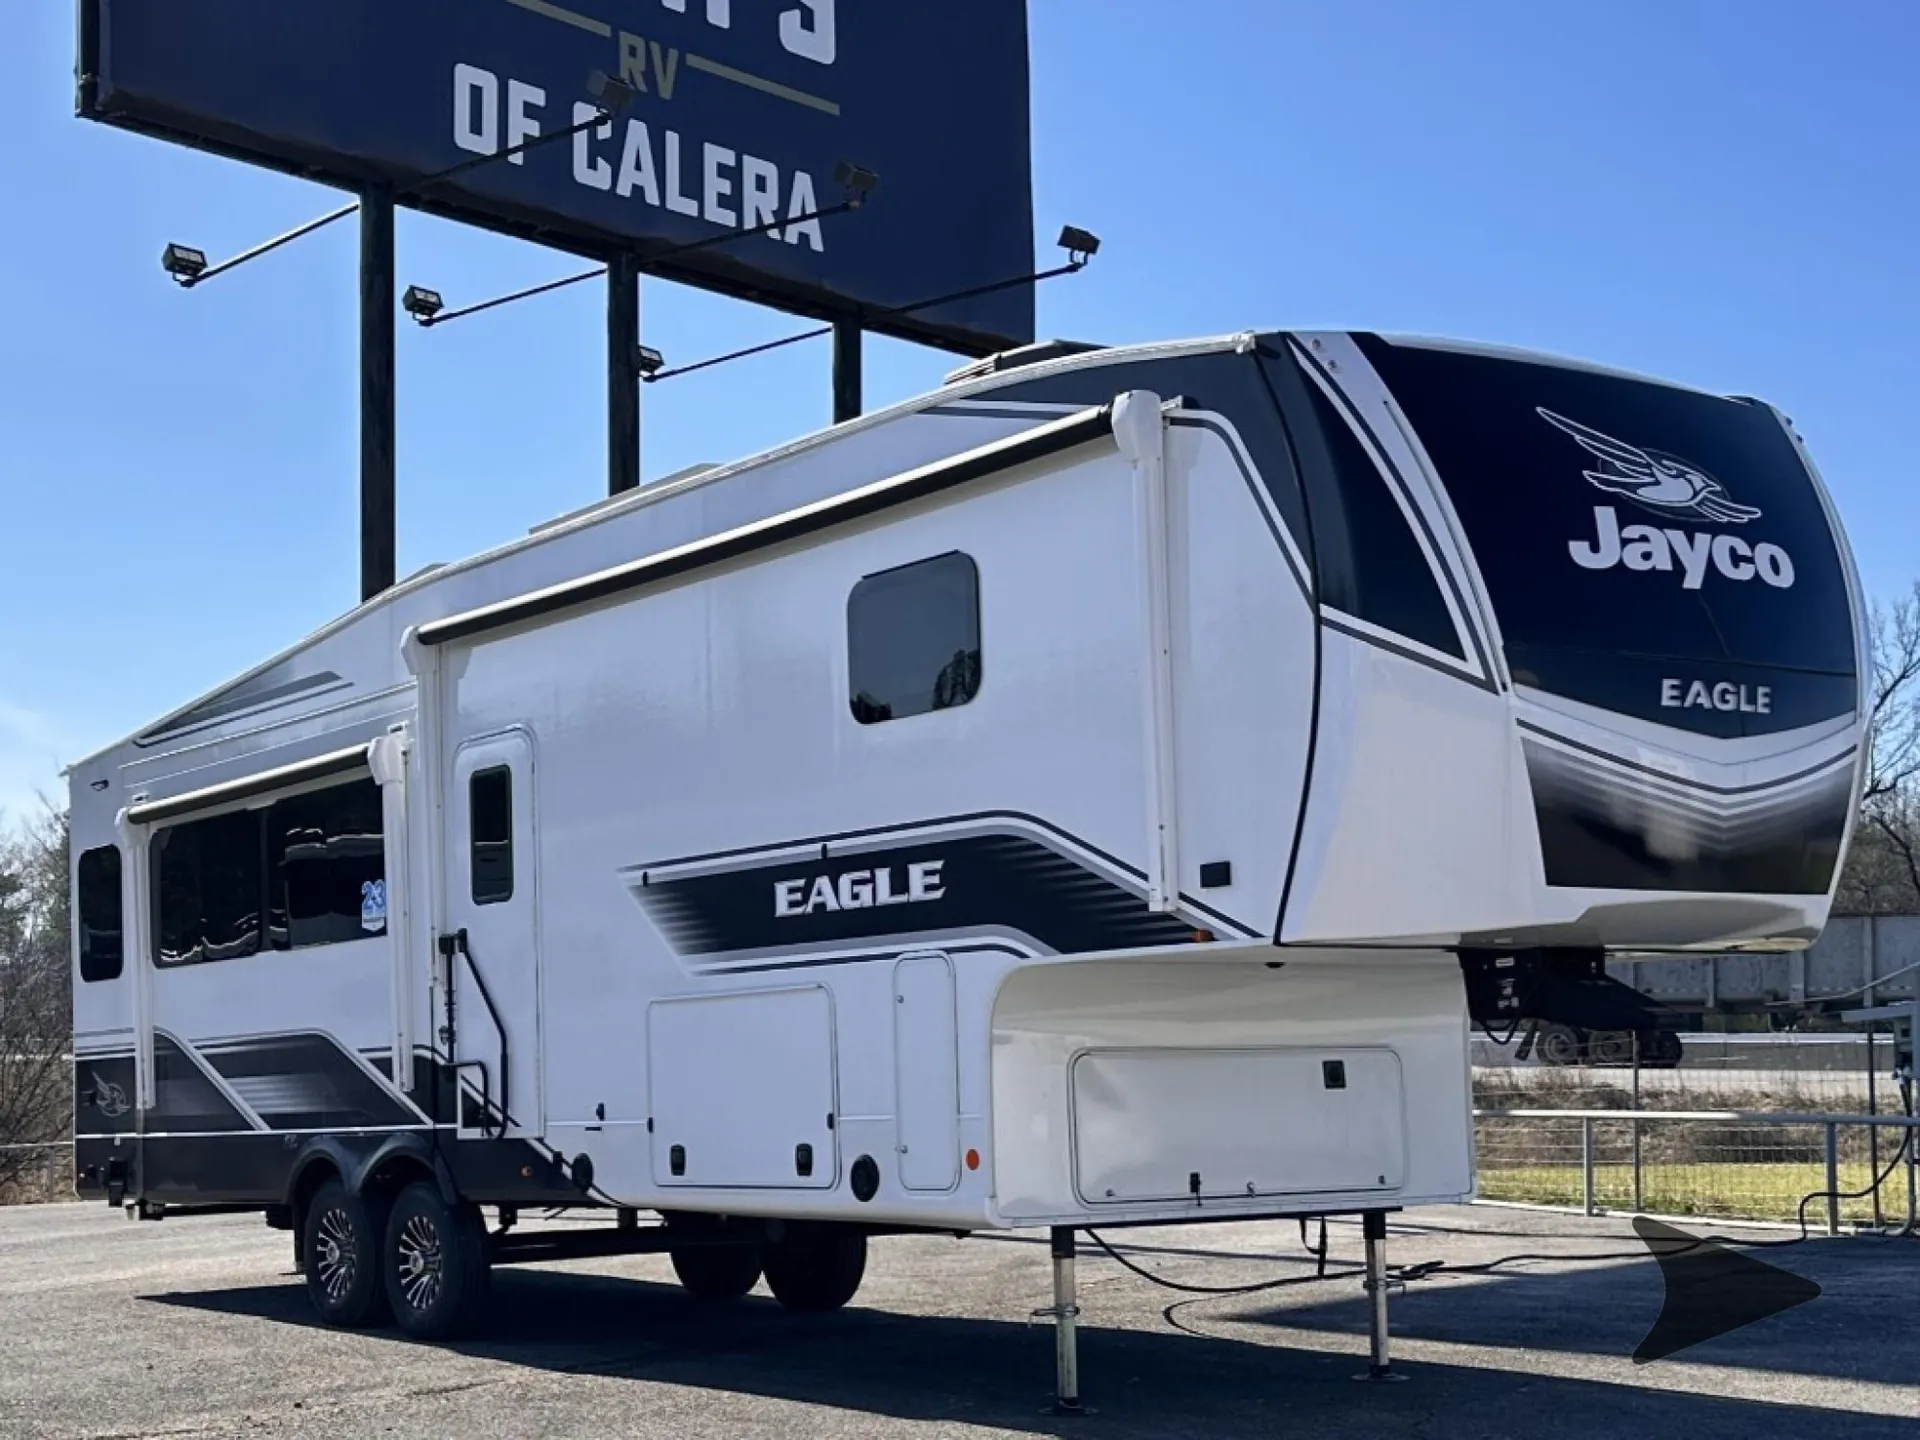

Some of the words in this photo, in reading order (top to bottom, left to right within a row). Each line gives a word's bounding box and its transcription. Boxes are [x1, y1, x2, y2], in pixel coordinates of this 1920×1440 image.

[619, 31, 679, 100] RV
[453, 62, 546, 166] OF
[572, 100, 824, 252] CALERA
[1568, 505, 1795, 589] Jayco
[1660, 678, 1771, 713] EAGLE
[774, 859, 946, 918] EAGLE
